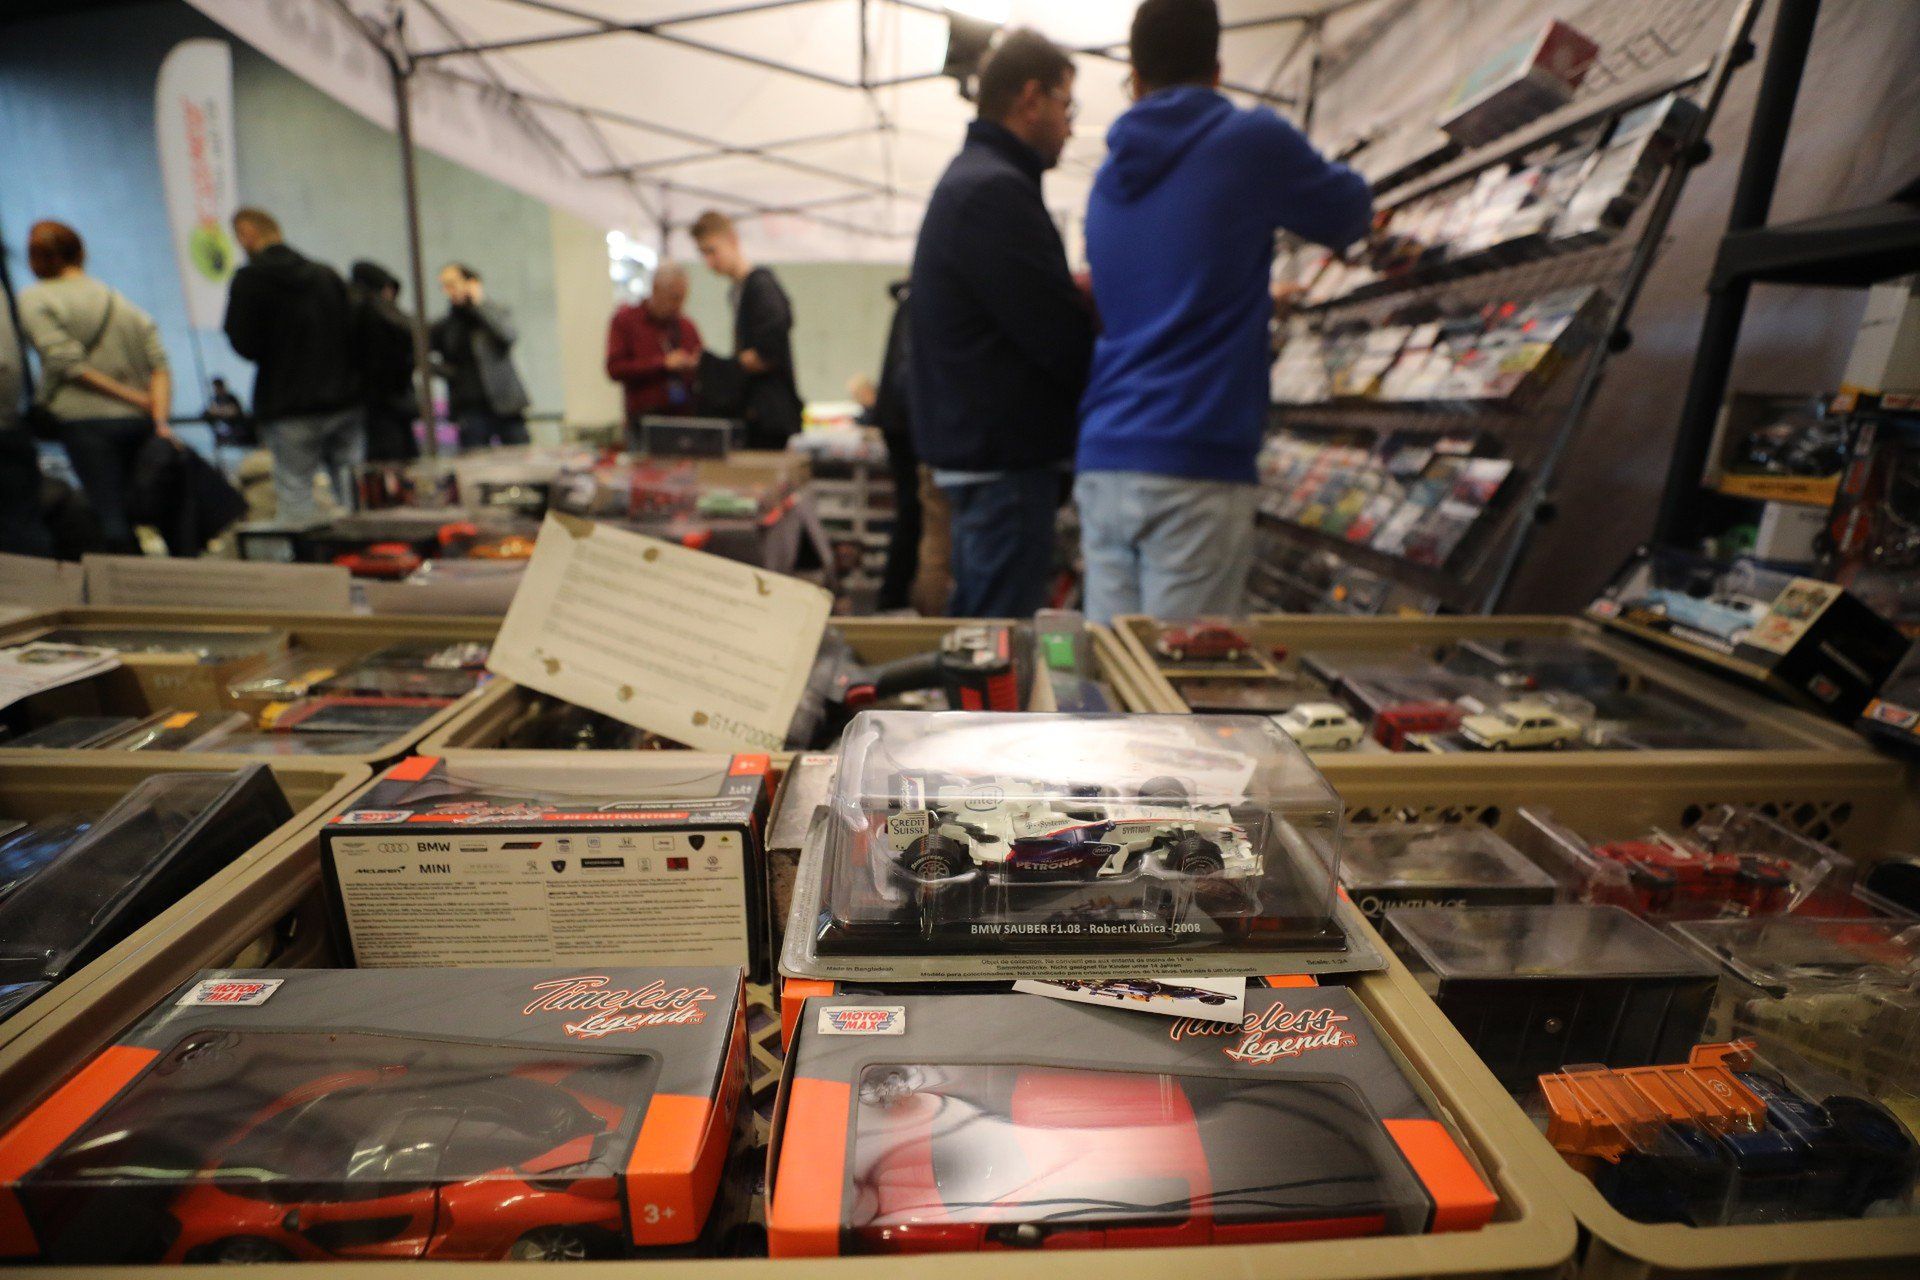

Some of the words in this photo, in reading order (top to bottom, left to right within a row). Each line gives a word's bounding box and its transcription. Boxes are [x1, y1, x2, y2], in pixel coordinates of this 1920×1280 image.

[968, 790, 999, 805] intel
[890, 818, 925, 828] CREDIT
[893, 827, 924, 835] SUISSE
[417, 841, 450, 852] BMW
[419, 864, 451, 874] MINI
[970, 924, 1001, 935] BMW
[1003, 924, 1048, 935] SAUBER
[1050, 924, 1081, 934] F1.08
[1090, 923, 1126, 934] Robert
[1129, 923, 1166, 934] Kubica
[1174, 923, 1201, 933] 2008
[208, 983, 265, 994] MOTOR
[203, 992, 243, 1002] MAX
[523, 976, 717, 1015] Timeless
[564, 1005, 703, 1039] Legends
[837, 1010, 890, 1022] MOTOR
[840, 1020, 880, 1032] MAX
[1224, 1025, 1351, 1064] Legends
[643, 1202, 676, 1225] 3+
